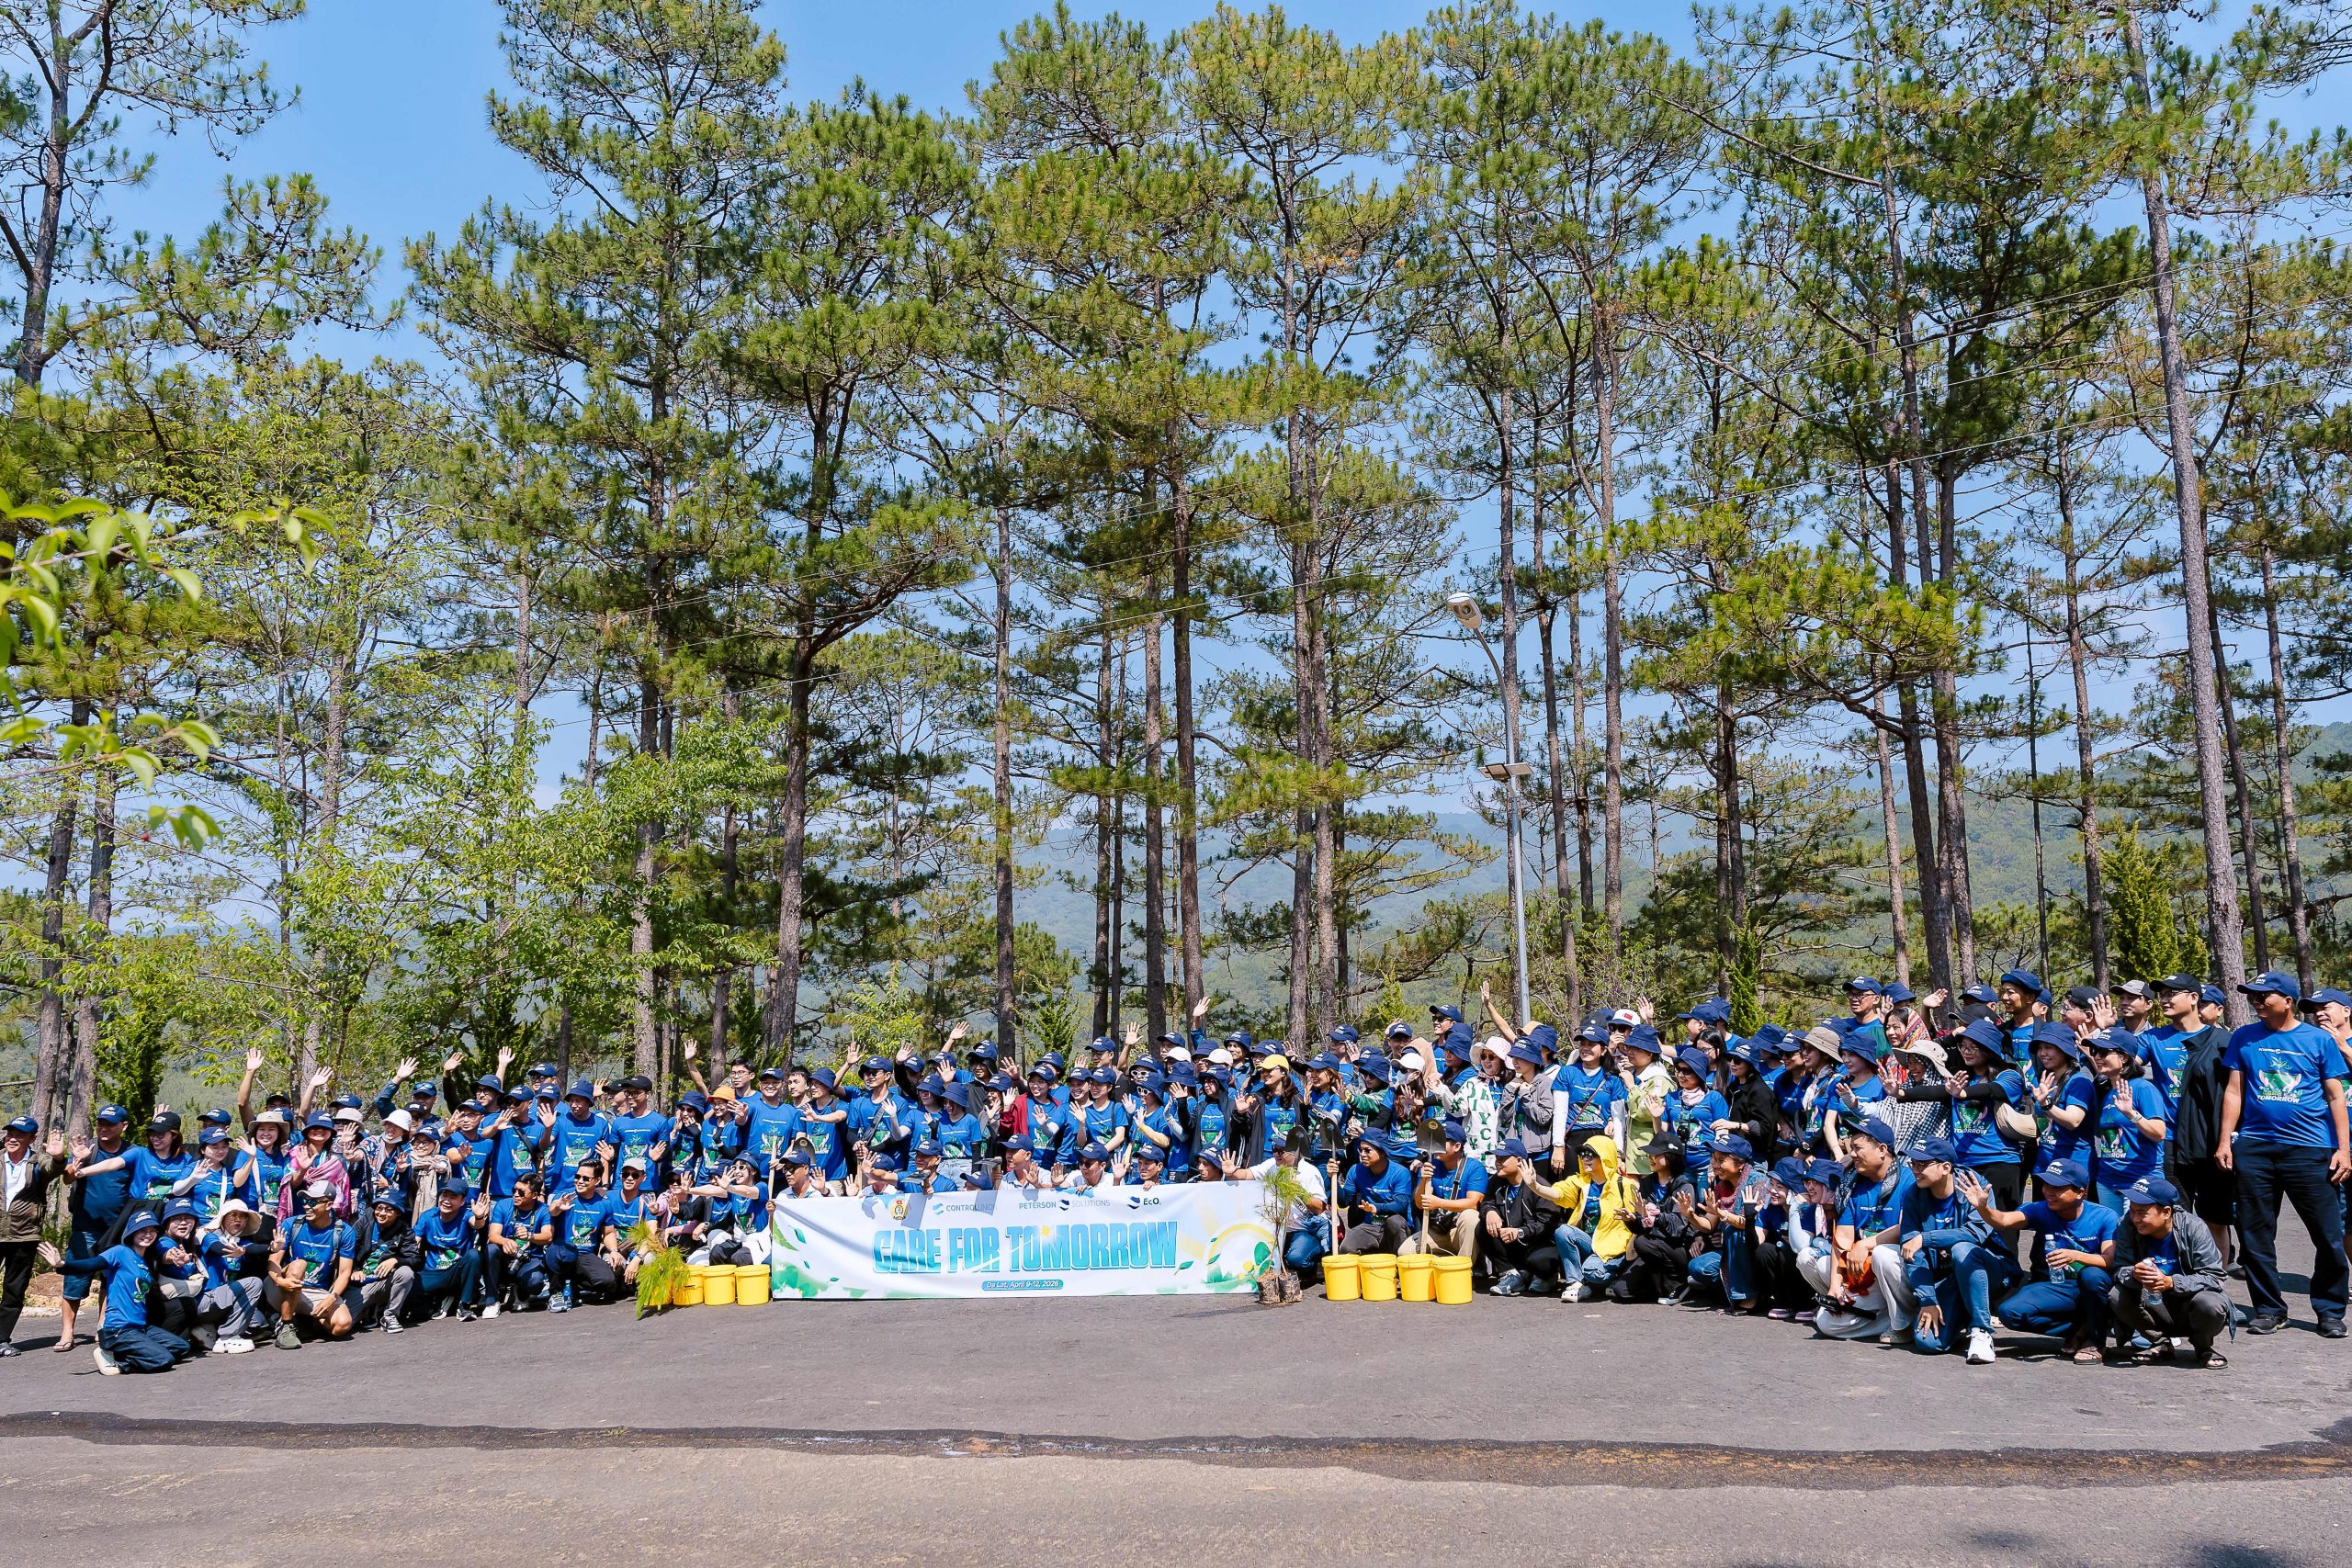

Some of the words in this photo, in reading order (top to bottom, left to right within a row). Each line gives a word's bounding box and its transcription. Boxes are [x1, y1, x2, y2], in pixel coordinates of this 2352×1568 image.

[2257, 1095, 2300, 1103] TOMORROW
[873, 1228, 940, 1274] CARE
[947, 1226, 1000, 1273] FOR
[1005, 1221, 1178, 1272] TOMORROW
[1010, 1280, 1024, 1289] April
